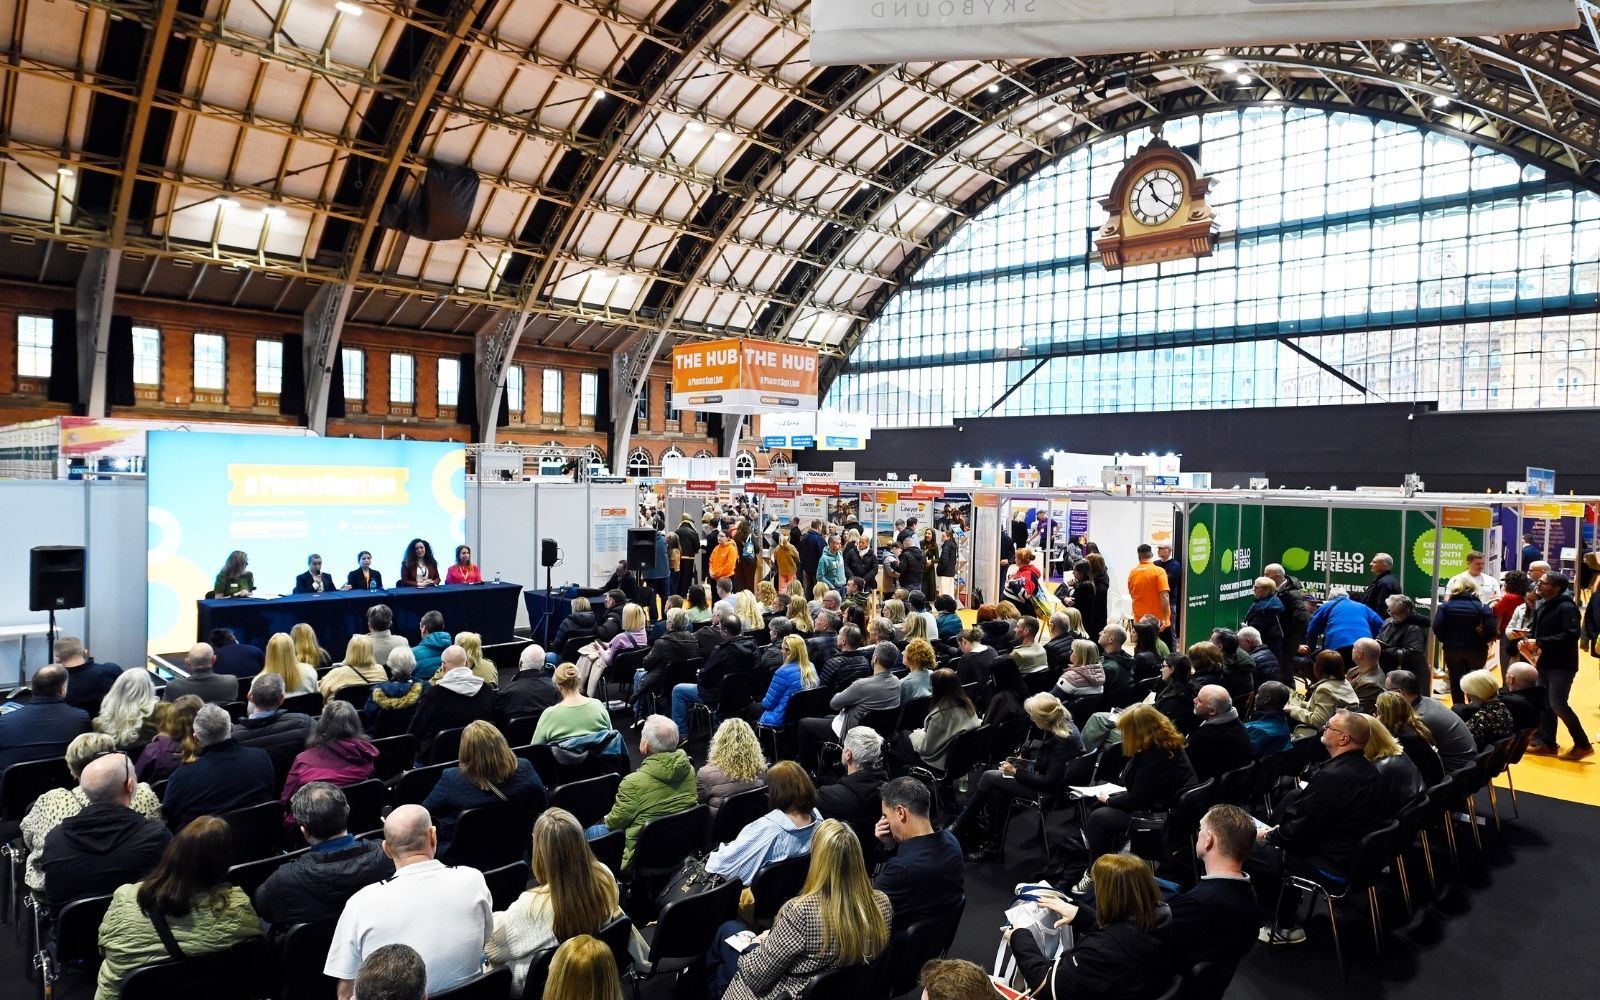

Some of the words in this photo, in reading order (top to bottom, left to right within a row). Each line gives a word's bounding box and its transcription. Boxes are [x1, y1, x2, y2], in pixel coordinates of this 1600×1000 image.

[675, 352, 702, 370] THE
[706, 348, 738, 367] HUB
[744, 349, 777, 367] THE
[782, 353, 816, 372] HUB
[1234, 548, 1250, 560] HELLO
[1314, 551, 1364, 563] HELLO
[1234, 559, 1250, 571] FRESH
[1314, 561, 1364, 574] FRESH
